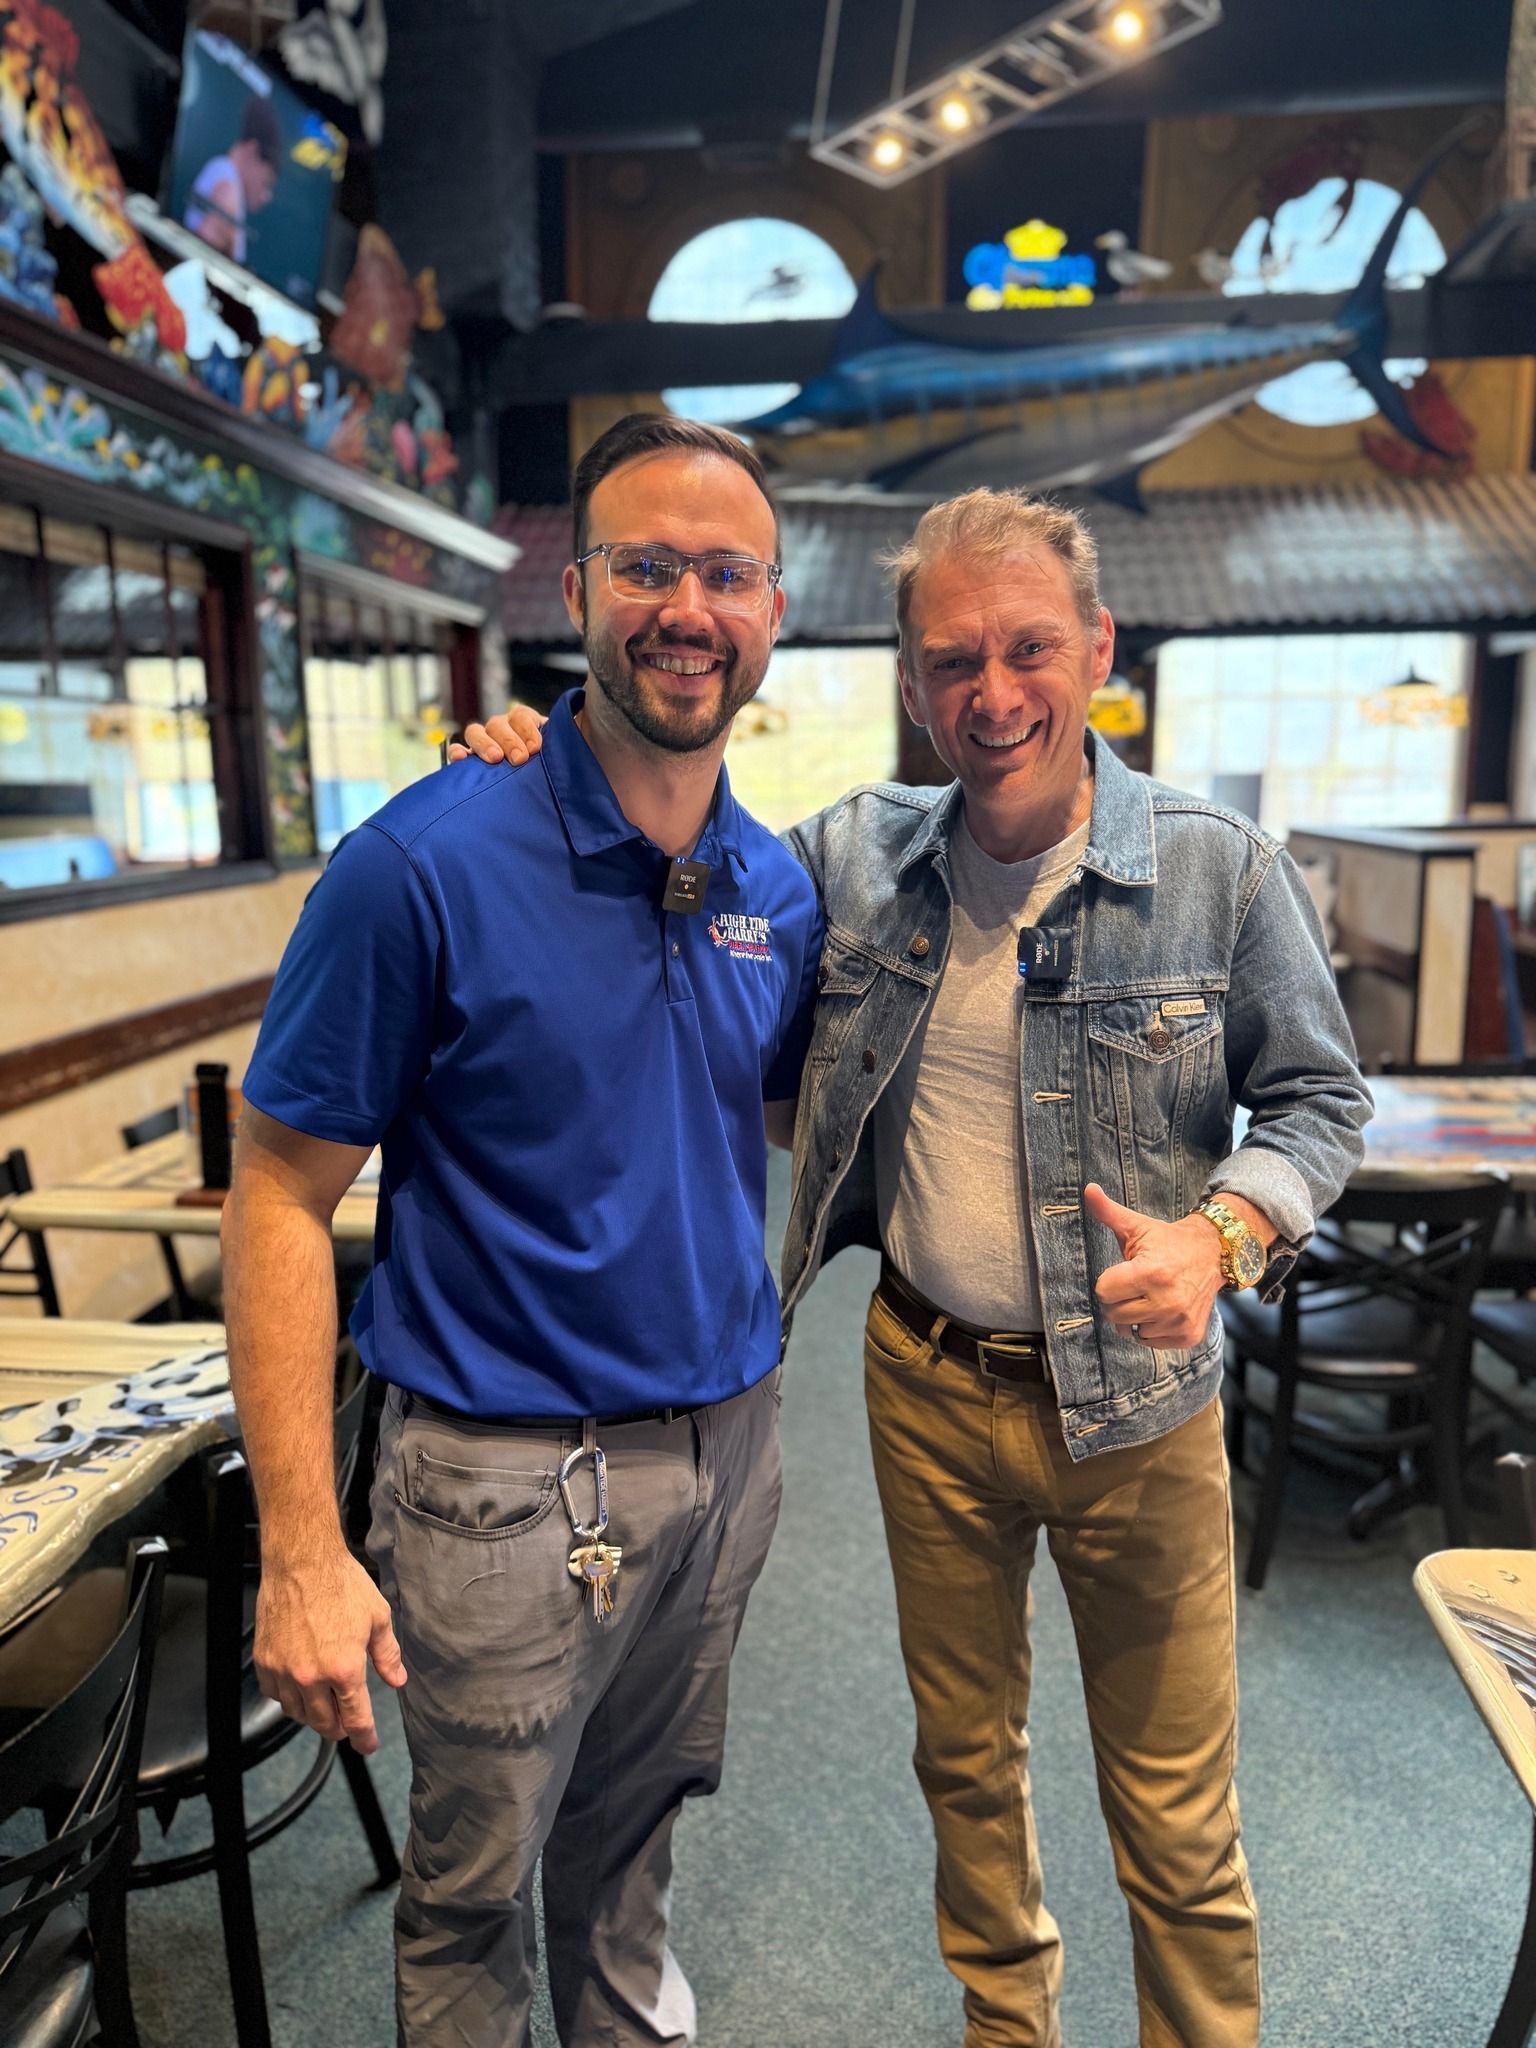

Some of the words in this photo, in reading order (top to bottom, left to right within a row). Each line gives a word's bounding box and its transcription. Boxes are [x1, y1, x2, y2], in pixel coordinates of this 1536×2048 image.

[719, 913, 747, 929] HIGH
[748, 916, 770, 932] TIDE
[727, 927, 767, 944] HARRY'S
[1163, 1003, 1189, 1014] Calvin
